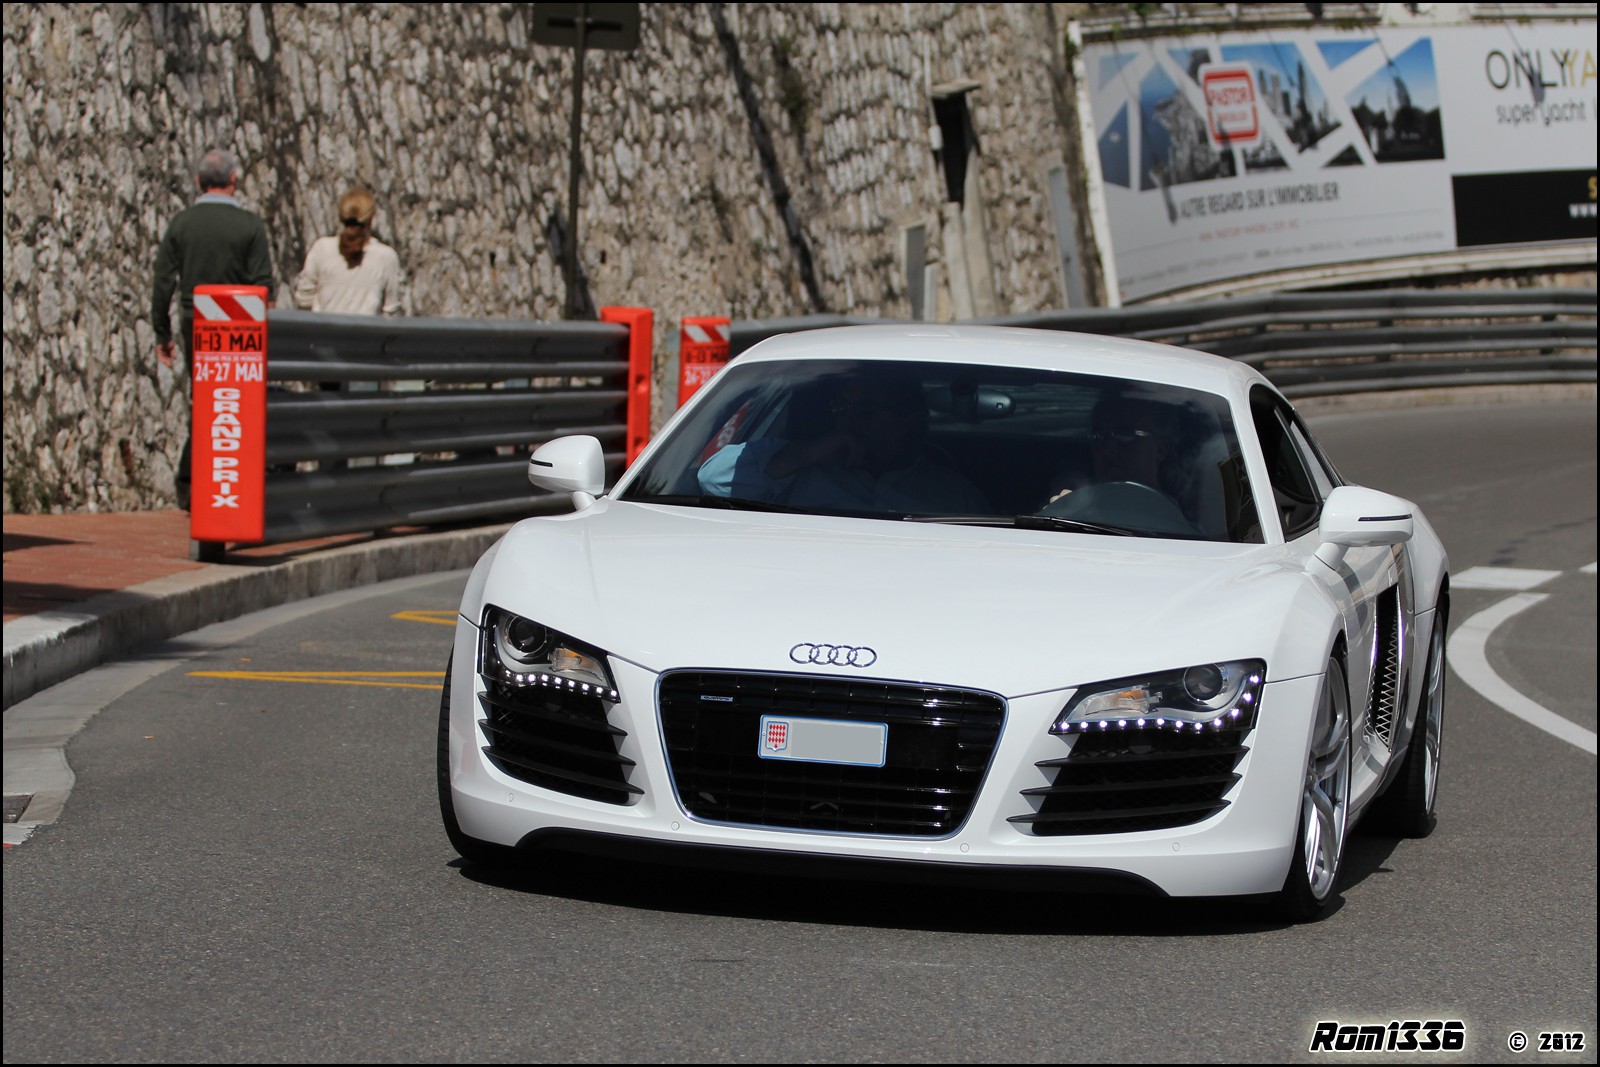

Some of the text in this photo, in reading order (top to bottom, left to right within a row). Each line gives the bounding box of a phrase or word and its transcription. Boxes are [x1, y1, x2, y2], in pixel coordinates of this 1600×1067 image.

[1246, 187, 1265, 209] SUR
[195, 332, 262, 352] 11-13 MAI
[195, 362, 263, 382] 24-27 MAI
[211, 387, 242, 509] GRAND PRIX
